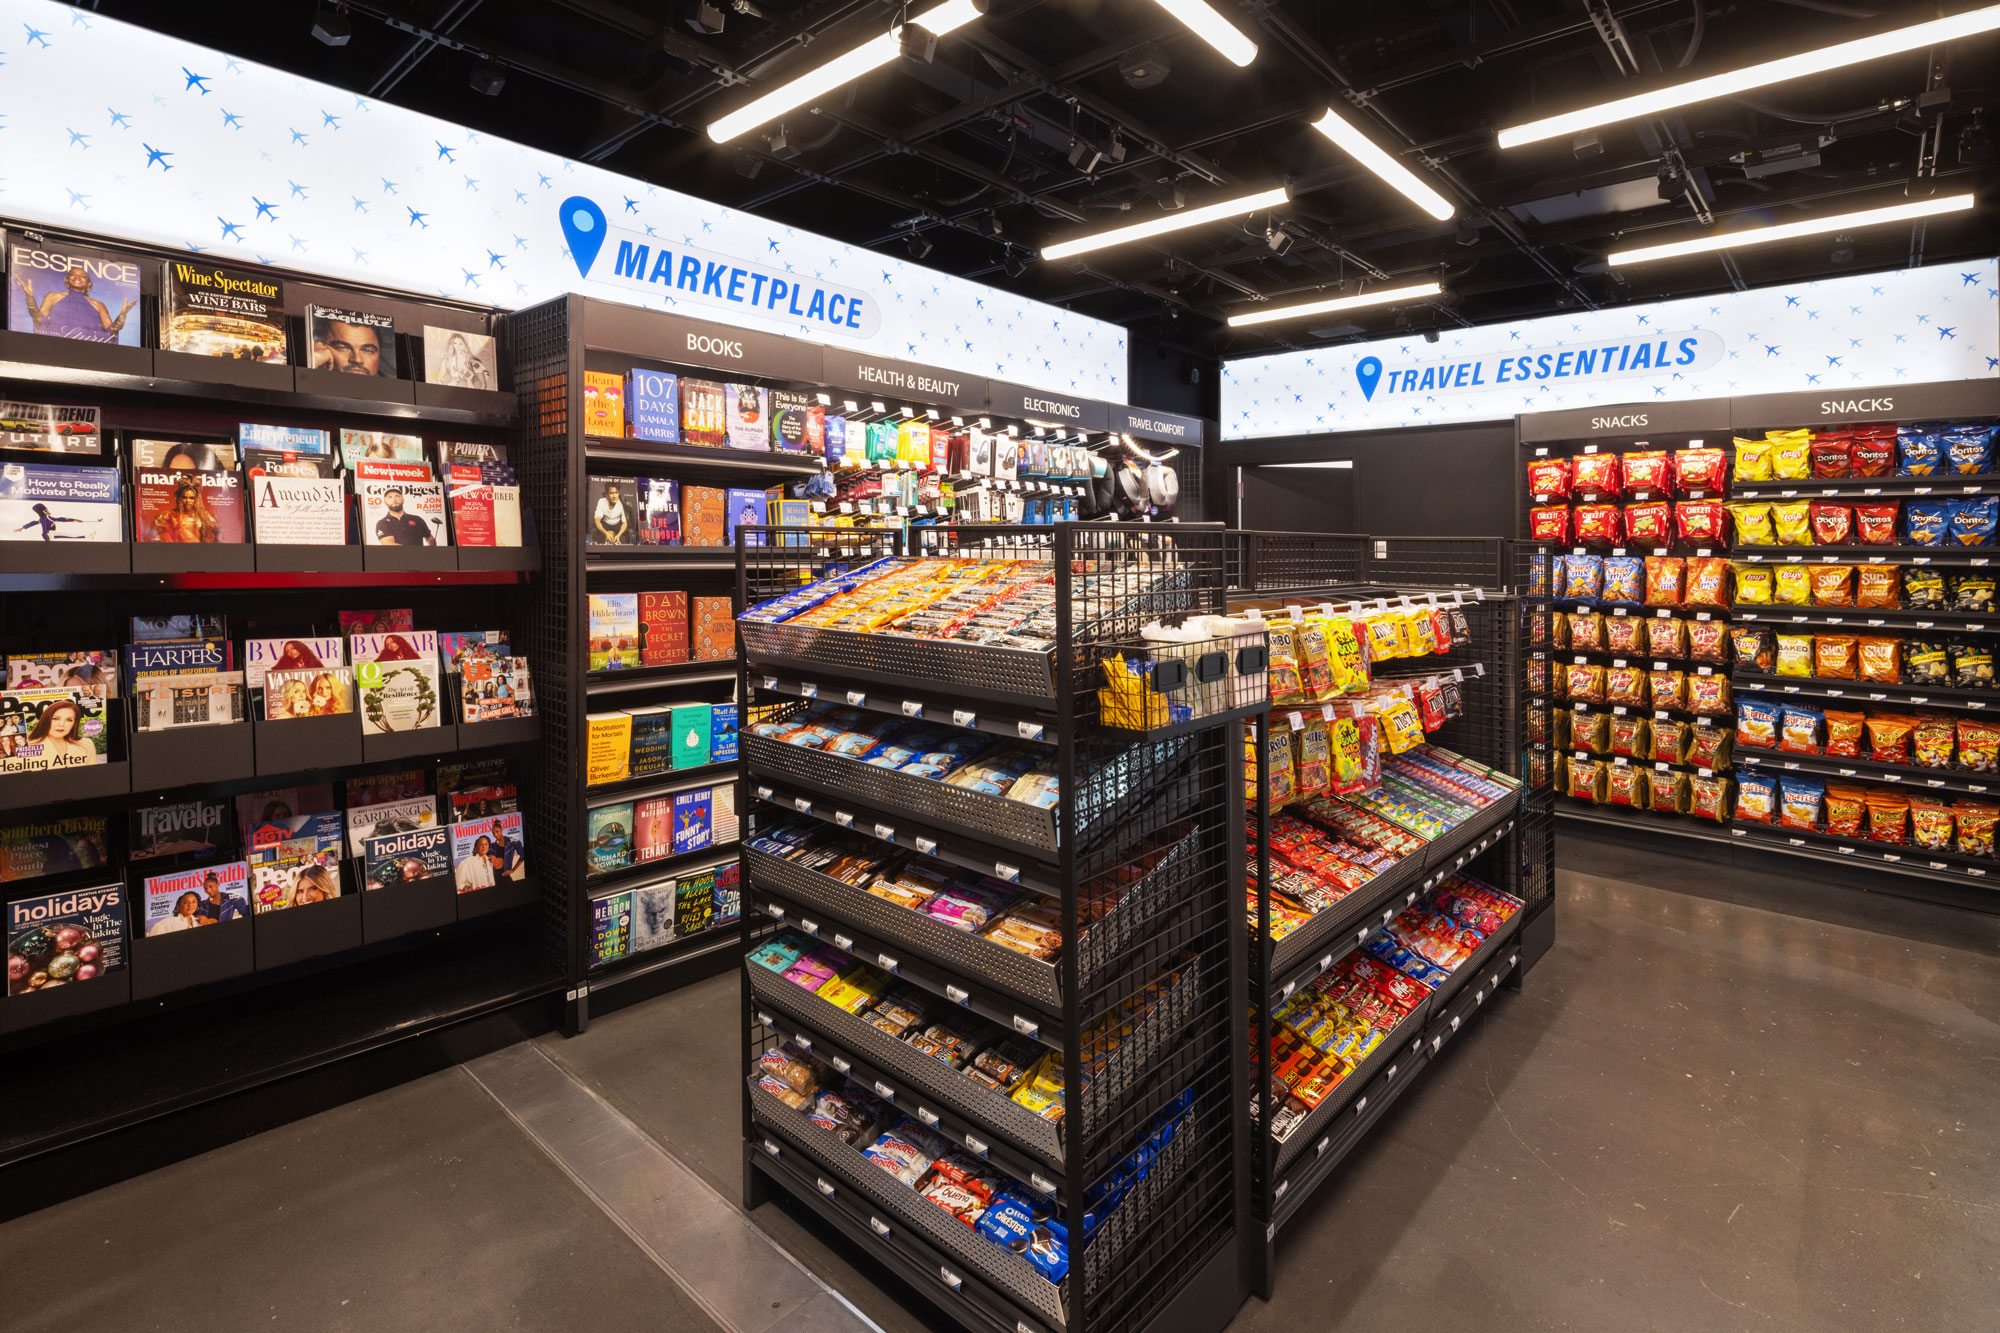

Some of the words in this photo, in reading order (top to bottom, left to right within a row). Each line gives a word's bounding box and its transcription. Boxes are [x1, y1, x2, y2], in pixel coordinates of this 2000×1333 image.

[13, 247, 138, 284] ESSENCE
[176, 263, 212, 287] Wine
[214, 270, 278, 297] Spectator
[613, 239, 864, 328] MARKETPLACE
[189, 293, 228, 308] WINE
[232, 299, 267, 313] BARS
[687, 333, 743, 358] BOOKS
[1388, 362, 1485, 394] TRAVEL
[1496, 337, 1698, 383] ESSENTIALS
[587, 374, 614, 386] Heart
[638, 374, 674, 399] 107
[858, 365, 904, 387] HEALTH
[907, 374, 916, 389] &
[918, 376, 960, 397] BEAUTY
[688, 391, 723, 412] JACK
[775, 391, 790, 402] This
[790, 393, 798, 402] Is
[798, 393, 807, 403] for
[593, 399, 610, 410] the
[640, 399, 674, 415] DAYS
[775, 401, 807, 413] Everyone
[1024, 397, 1080, 418] ELECTRONICS
[1821, 397, 1894, 415] SNACKS
[588, 416, 616, 428] Lover
[640, 414, 675, 427] KAMALA
[688, 409, 722, 430] CARR
[1128, 415, 1152, 432] TRAVEL
[1153, 421, 1185, 436] COMFORT
[1591, 414, 1648, 429] SNACKS
[241, 424, 319, 445] Entrepreneur
[641, 426, 675, 439] HARRIS
[454, 442, 490, 457] POWER
[1857, 450, 1889, 460] Doritos
[1904, 446, 1938, 456] Doritos
[1949, 445, 1985, 455] Doritos
[1817, 453, 1848, 463] Doritos
[264, 461, 316, 476] Forbes
[363, 465, 425, 478] Newsweek
[28, 478, 58, 489] How
[59, 480, 73, 489] to
[74, 480, 111, 492] Really
[11, 485, 67, 498] Motivate
[69, 488, 111, 500] People
[458, 491, 480, 500] NEW
[480, 491, 514, 501] YORKER
[733, 491, 766, 499] REPLACEABLE
[367, 497, 383, 506] 50
[786, 506, 805, 515] Mitch
[653, 517, 668, 528] THE
[785, 515, 807, 523] Albom
[1816, 514, 1848, 524] Doritos
[1860, 514, 1892, 524] Doritos
[1910, 514, 1943, 524] Doritos
[1953, 515, 1990, 525] Doritos
[1607, 566, 1631, 575] Chex
[1781, 571, 1803, 581] Lay's
[1818, 574, 1842, 588] Sun
[1861, 572, 1885, 586] Sun
[645, 594, 686, 608] DAN
[592, 608, 636, 618] Hilderbrand
[645, 609, 686, 622] BROWN
[650, 632, 685, 643] SECRET
[648, 648, 686, 659] SECRETS
[1338, 641, 1360, 656] SOUR
[1778, 645, 1809, 653] BAKED
[1820, 643, 1843, 657] Sun
[1865, 644, 1887, 658] Sun
[1912, 652, 1946, 665] Smartfood
[1957, 657, 1993, 666] Smartfood
[137, 670, 168, 678] SOLDIERS
[180, 667, 218, 676] MISFORTUNE
[361, 662, 381, 680] O
[145, 686, 238, 701] LEISURE
[382, 690, 420, 699] Resilience
[1744, 709, 1775, 722] RUFFLES
[1784, 716, 1817, 728] RUFFLES
[592, 723, 626, 732] Meditations
[601, 730, 623, 738] Mortals
[1831, 725, 1859, 736] Cheetos
[1876, 732, 1902, 744] Cheetos
[1916, 729, 1948, 740] Cheetos
[1966, 730, 1999, 741] Cheetos
[15, 744, 44, 753] PRISCILLA
[17, 750, 42, 758] PRESLEY
[634, 744, 668, 754] WEDDING
[52, 753, 88, 767] After
[639, 756, 663, 765] JASON
[590, 764, 610, 773] Oliver
[1739, 782, 1772, 795] RUFFLES
[676, 794, 694, 806] EMILY
[694, 790, 711, 802] HENRY
[1785, 792, 1819, 806] RUFFLES
[641, 806, 671, 818] McFADDEN
[646, 801, 666, 810] FREIDA
[1831, 806, 1858, 817] Cheetos
[137, 801, 225, 837] Traveler
[593, 808, 631, 821] Playground
[1873, 811, 1902, 823] Cheetos
[1917, 810, 1950, 820] Cheetos
[1960, 816, 1994, 827] Cheetos
[253, 827, 295, 846] HGTV
[676, 823, 701, 844] FUNNY
[687, 829, 711, 850] STORY
[254, 841, 281, 850] magazine
[374, 832, 446, 856] holidays
[421, 850, 441, 859] Magic
[594, 851, 627, 864] RICHARD
[641, 843, 670, 860] TENANT
[8, 861, 44, 872] South
[423, 862, 447, 871] Making
[596, 857, 625, 869] POWERS
[678, 881, 691, 890] THE
[693, 874, 715, 888] HOUSE
[684, 886, 710, 900] ACROSS
[726, 890, 740, 902] DIE
[14, 889, 120, 924] holidays
[677, 901, 691, 910] THE
[692, 894, 712, 907] LAKE
[595, 900, 630, 920] HERRON
[82, 912, 111, 926] Magic
[92, 921, 102, 931] In
[105, 918, 123, 928] The
[681, 911, 701, 925] RILEY
[85, 927, 120, 942] Making
[597, 926, 627, 940] DOWN
[594, 934, 630, 950] CEMETERY
[598, 943, 626, 958] ROAD
[883, 1138, 918, 1158] donettes
[941, 1186, 970, 1203] bueno
[1005, 1207, 1030, 1223] OREO
[994, 1210, 1028, 1236] CAKESTERS
